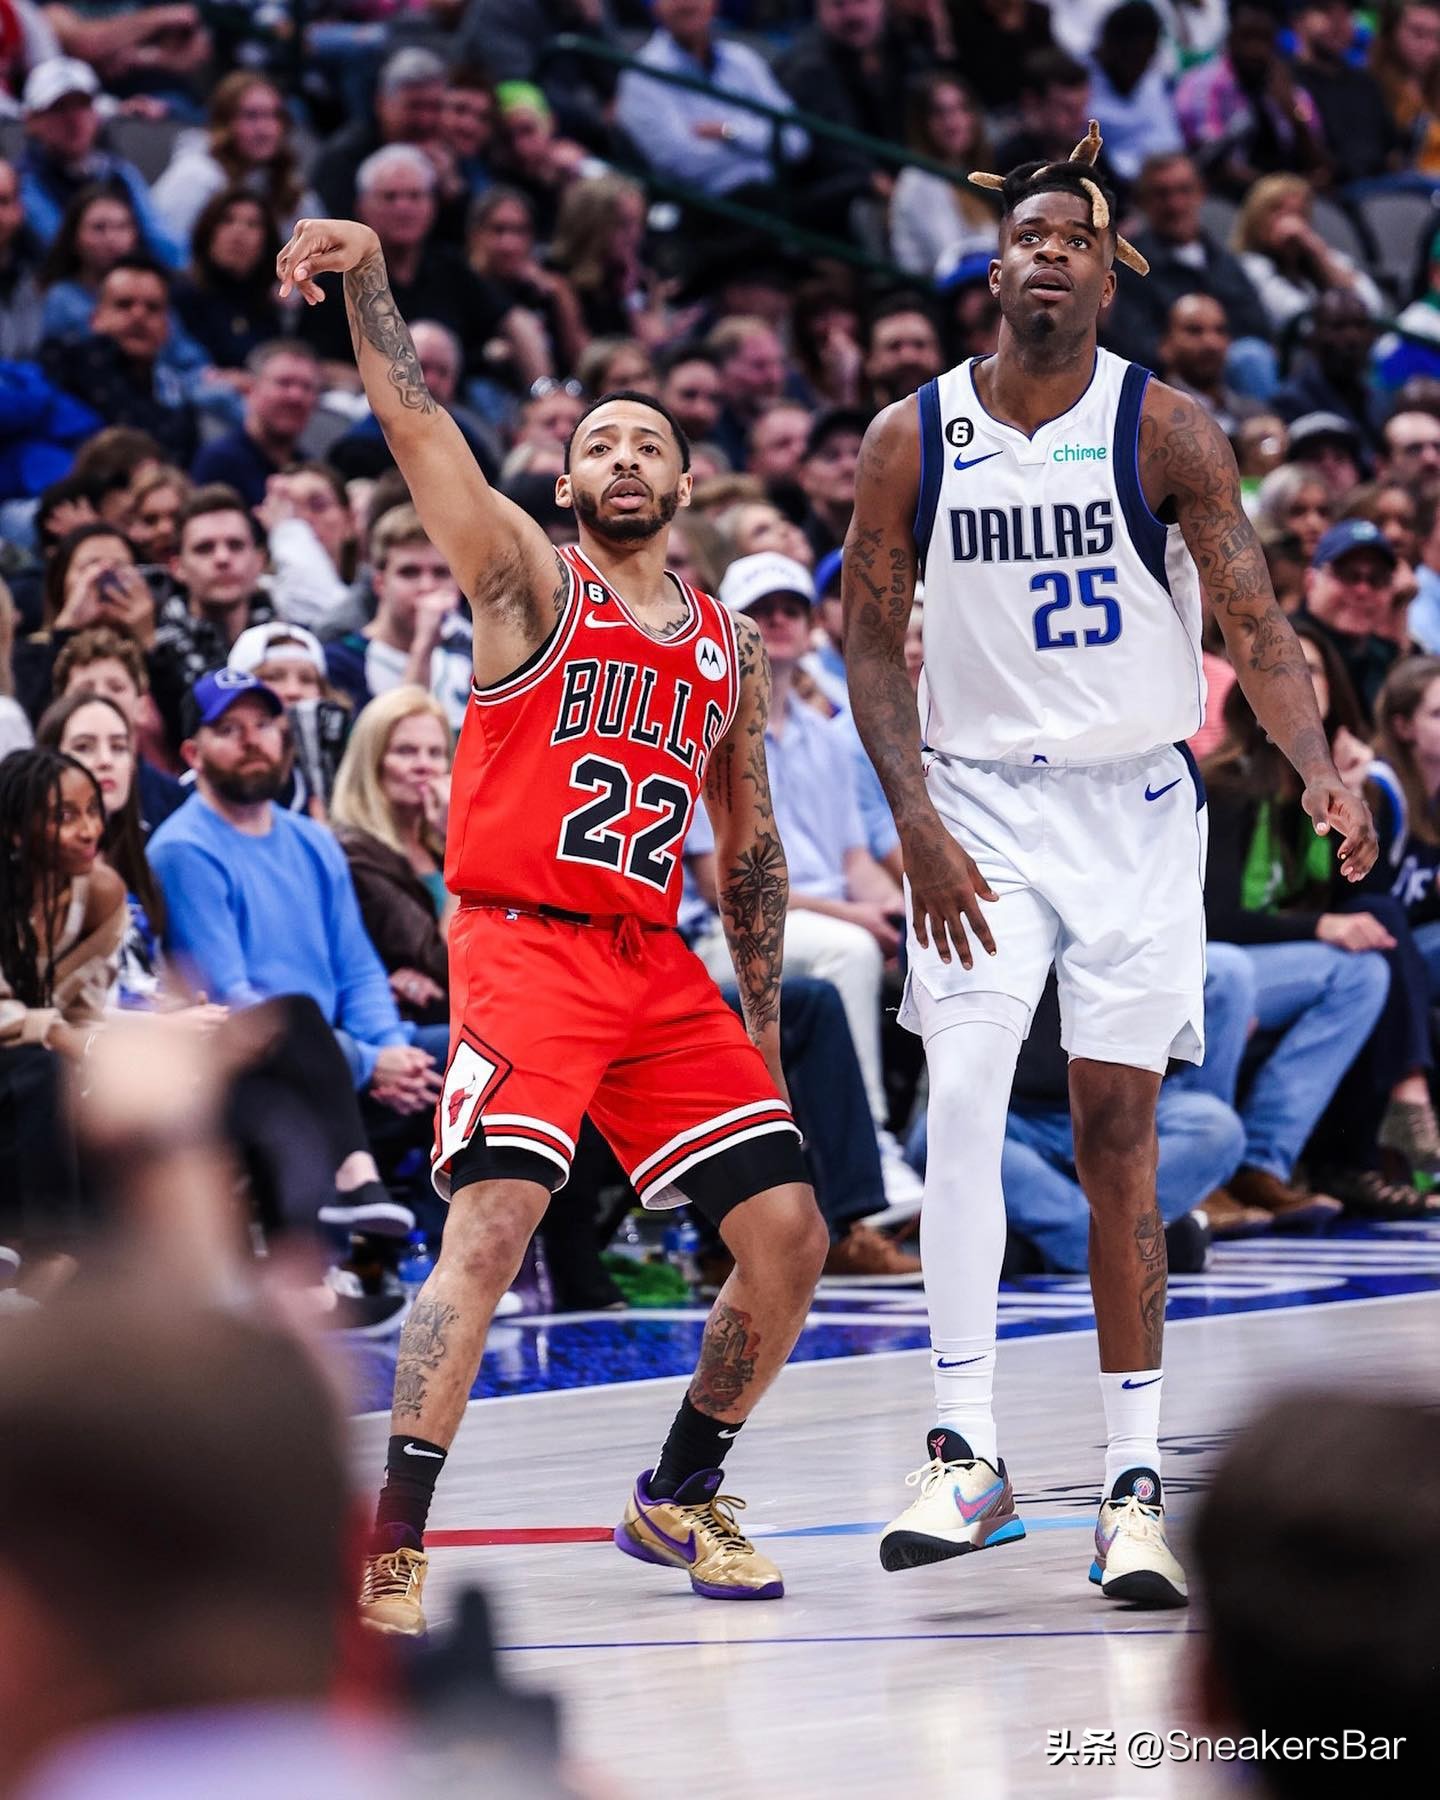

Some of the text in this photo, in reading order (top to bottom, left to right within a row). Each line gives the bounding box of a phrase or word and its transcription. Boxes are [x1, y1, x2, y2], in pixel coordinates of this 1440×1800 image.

[951, 420, 970, 444] 6
[1053, 443, 1108, 463] chime
[948, 498, 1115, 563] DALLAS
[587, 582, 605, 604] 6
[1029, 566, 1124, 651] 25
[556, 752, 693, 894] 22
